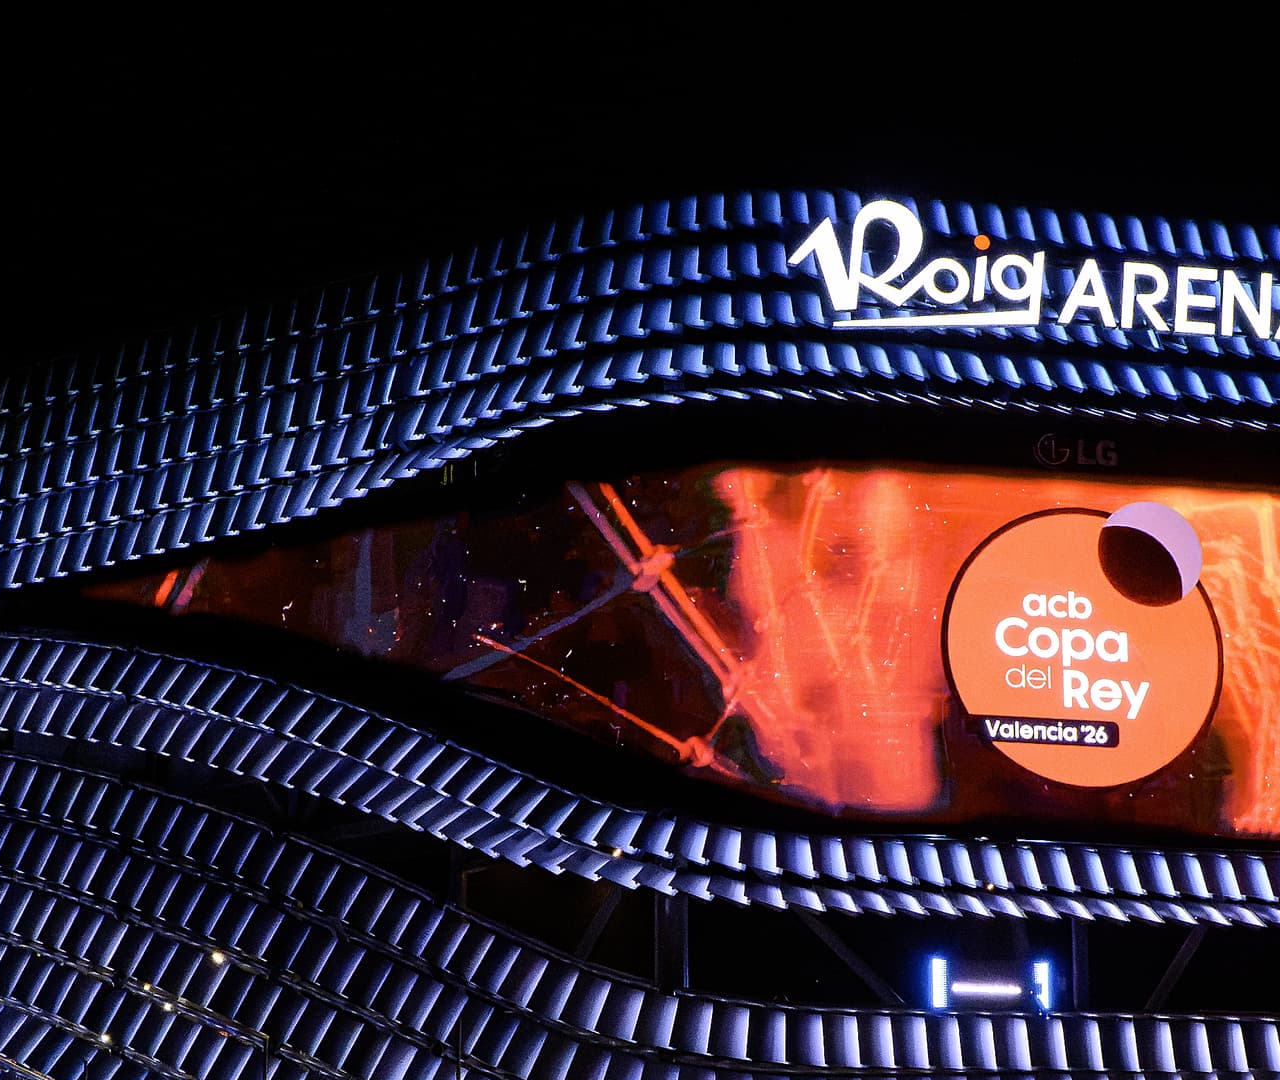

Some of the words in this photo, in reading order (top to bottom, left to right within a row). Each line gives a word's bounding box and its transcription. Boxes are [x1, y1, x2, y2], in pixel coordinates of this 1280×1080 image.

[787, 199, 1045, 328] Roig
[1077, 440, 1118, 465] LG
[1022, 591, 1093, 620] acb
[995, 616, 1129, 666] Copa
[1005, 663, 1052, 690] del
[1062, 669, 1150, 720] Rey
[985, 719, 1078, 743] Valencia
[1080, 725, 1109, 745] '26
